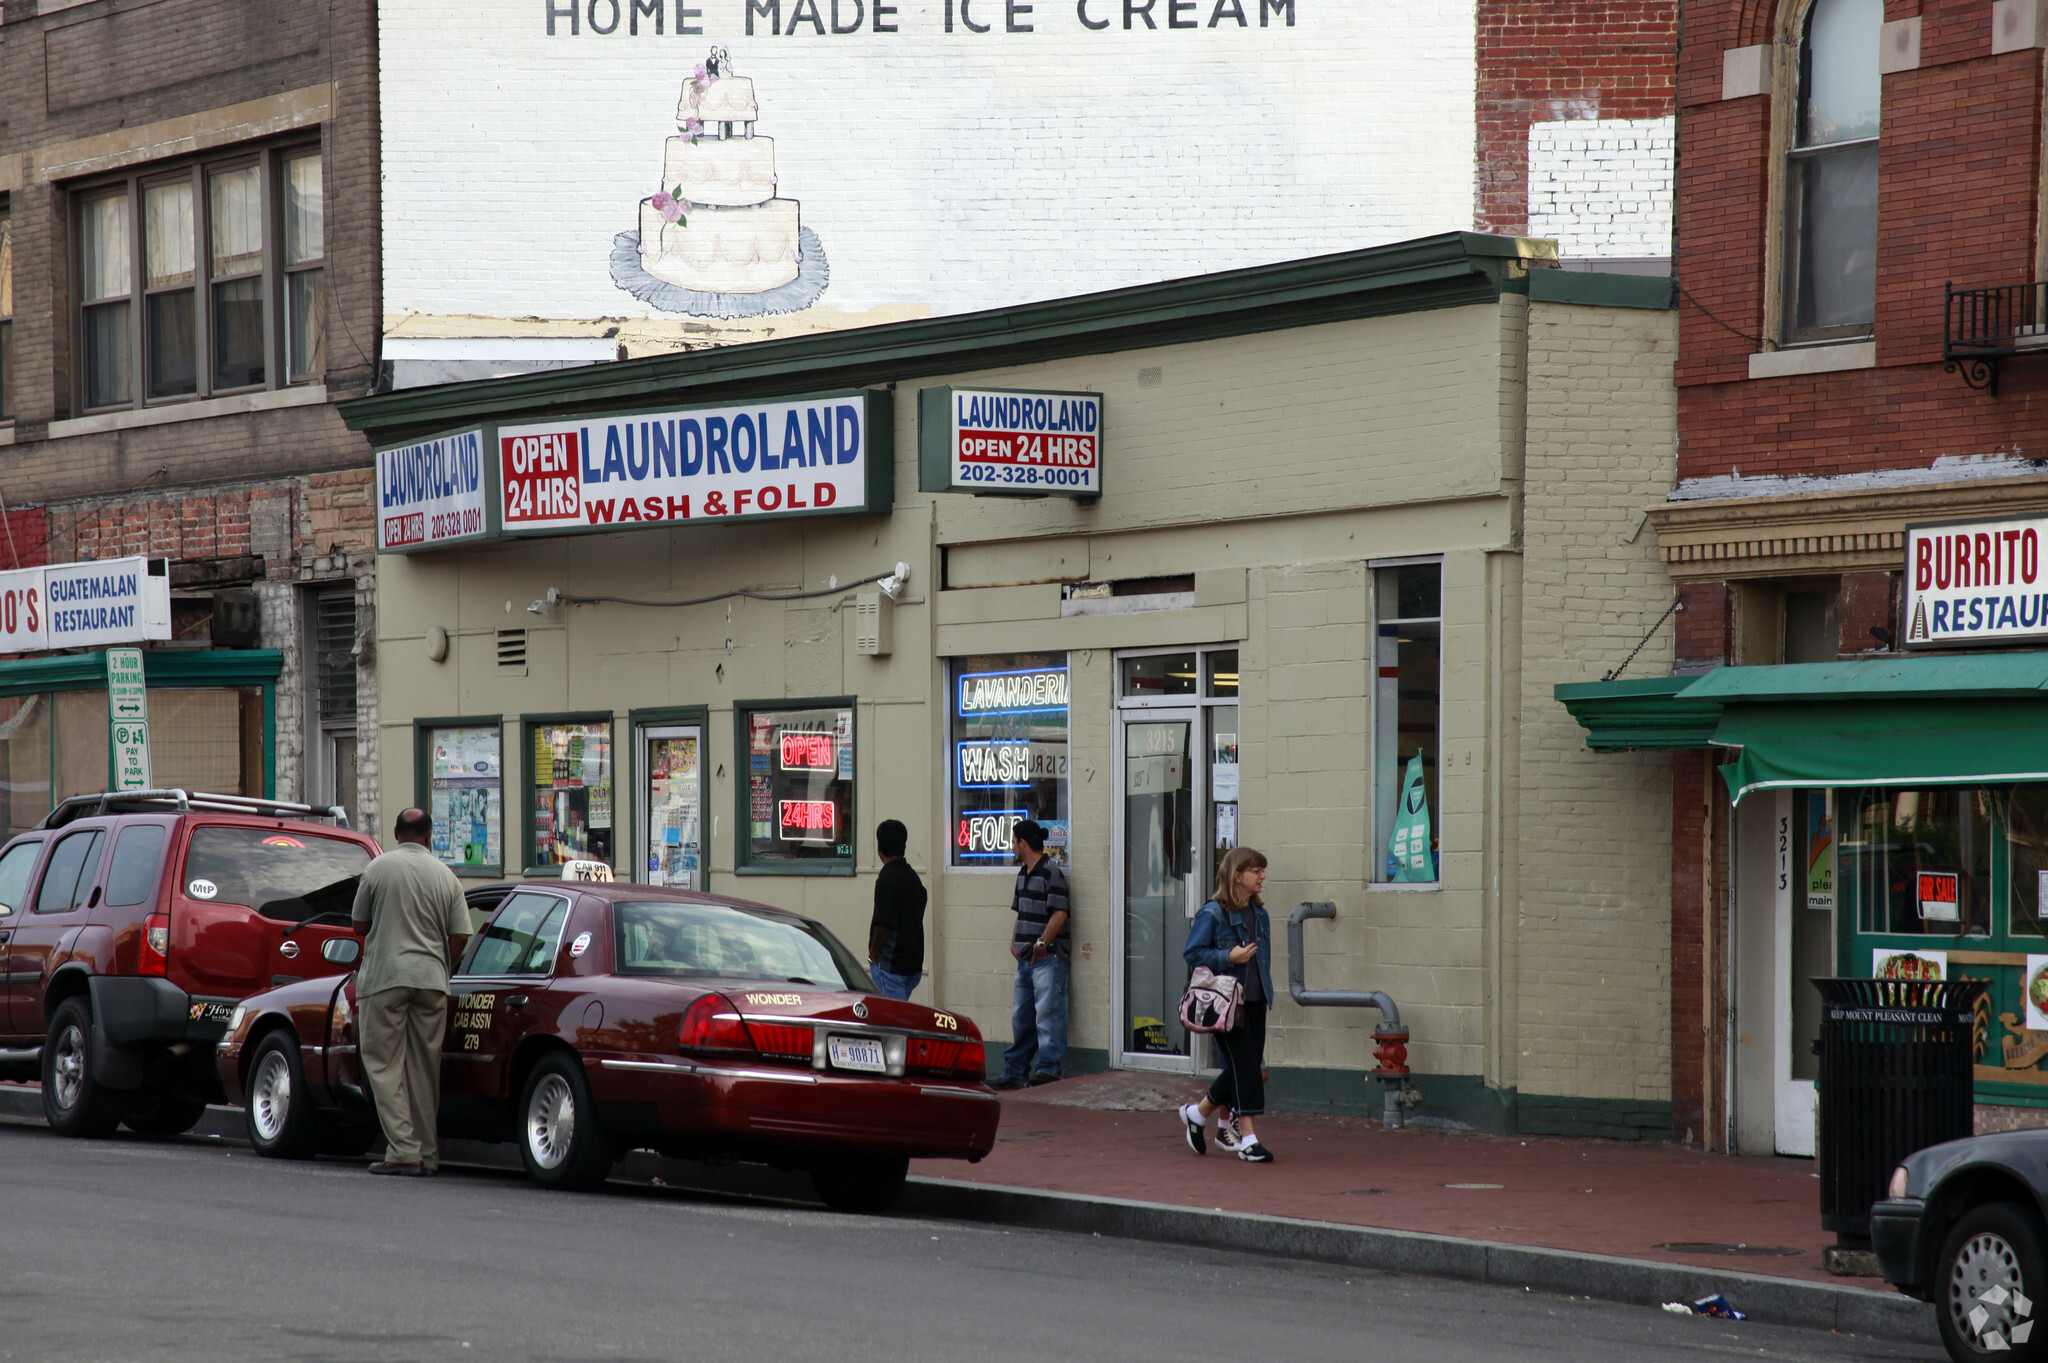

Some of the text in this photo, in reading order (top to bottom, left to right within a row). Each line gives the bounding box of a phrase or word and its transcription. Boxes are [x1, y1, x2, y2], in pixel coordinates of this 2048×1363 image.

[546, 0, 1295, 36] HOME MADE ICE CREAM
[958, 394, 1097, 432] LAUNDROLAND
[512, 434, 568, 475] OPEN
[580, 404, 860, 484] LAUNDROLAND
[961, 435, 1093, 466] OPEN 24 HRS
[382, 433, 479, 508] LAUNDROLAND
[960, 464, 1089, 486] 202-328-0001
[508, 476, 578, 518] 24 HRS
[584, 482, 837, 525] WASH & FOLD
[385, 517, 401, 545] OPEN
[431, 507, 482, 539] 202-328 0001
[1916, 527, 2038, 591] BURRITO
[50, 573, 137, 603] GUATEMALAN
[0, 587, 39, 635] O'S
[54, 604, 135, 633] RESTAURANT
[113, 657, 139, 669] 2 HOUR
[111, 671, 143, 684] PARKING
[125, 747, 139, 756] PAY
[781, 735, 832, 767] OPEN
[1146, 729, 1175, 752] 3215
[124, 767, 143, 776] PARK
[128, 757, 138, 766] TO
[962, 746, 1030, 783] WASH
[1779, 816, 1788, 891] 3213
[193, 883, 215, 894] MtP
[575, 871, 607, 882] TAXI
[1919, 875, 1957, 904] FOR SALE
[458, 993, 495, 1009] WONDER
[746, 993, 802, 1005] WONDER
[454, 1012, 469, 1028] CAB
[934, 1012, 957, 1031] 279
[1845, 1010, 1873, 1020] MOUNT
[1875, 1011, 1916, 1021] PLEASANT
[1917, 1012, 1942, 1022] CLEAN
[464, 1034, 480, 1050] 279
[832, 1044, 881, 1064] H 90871
